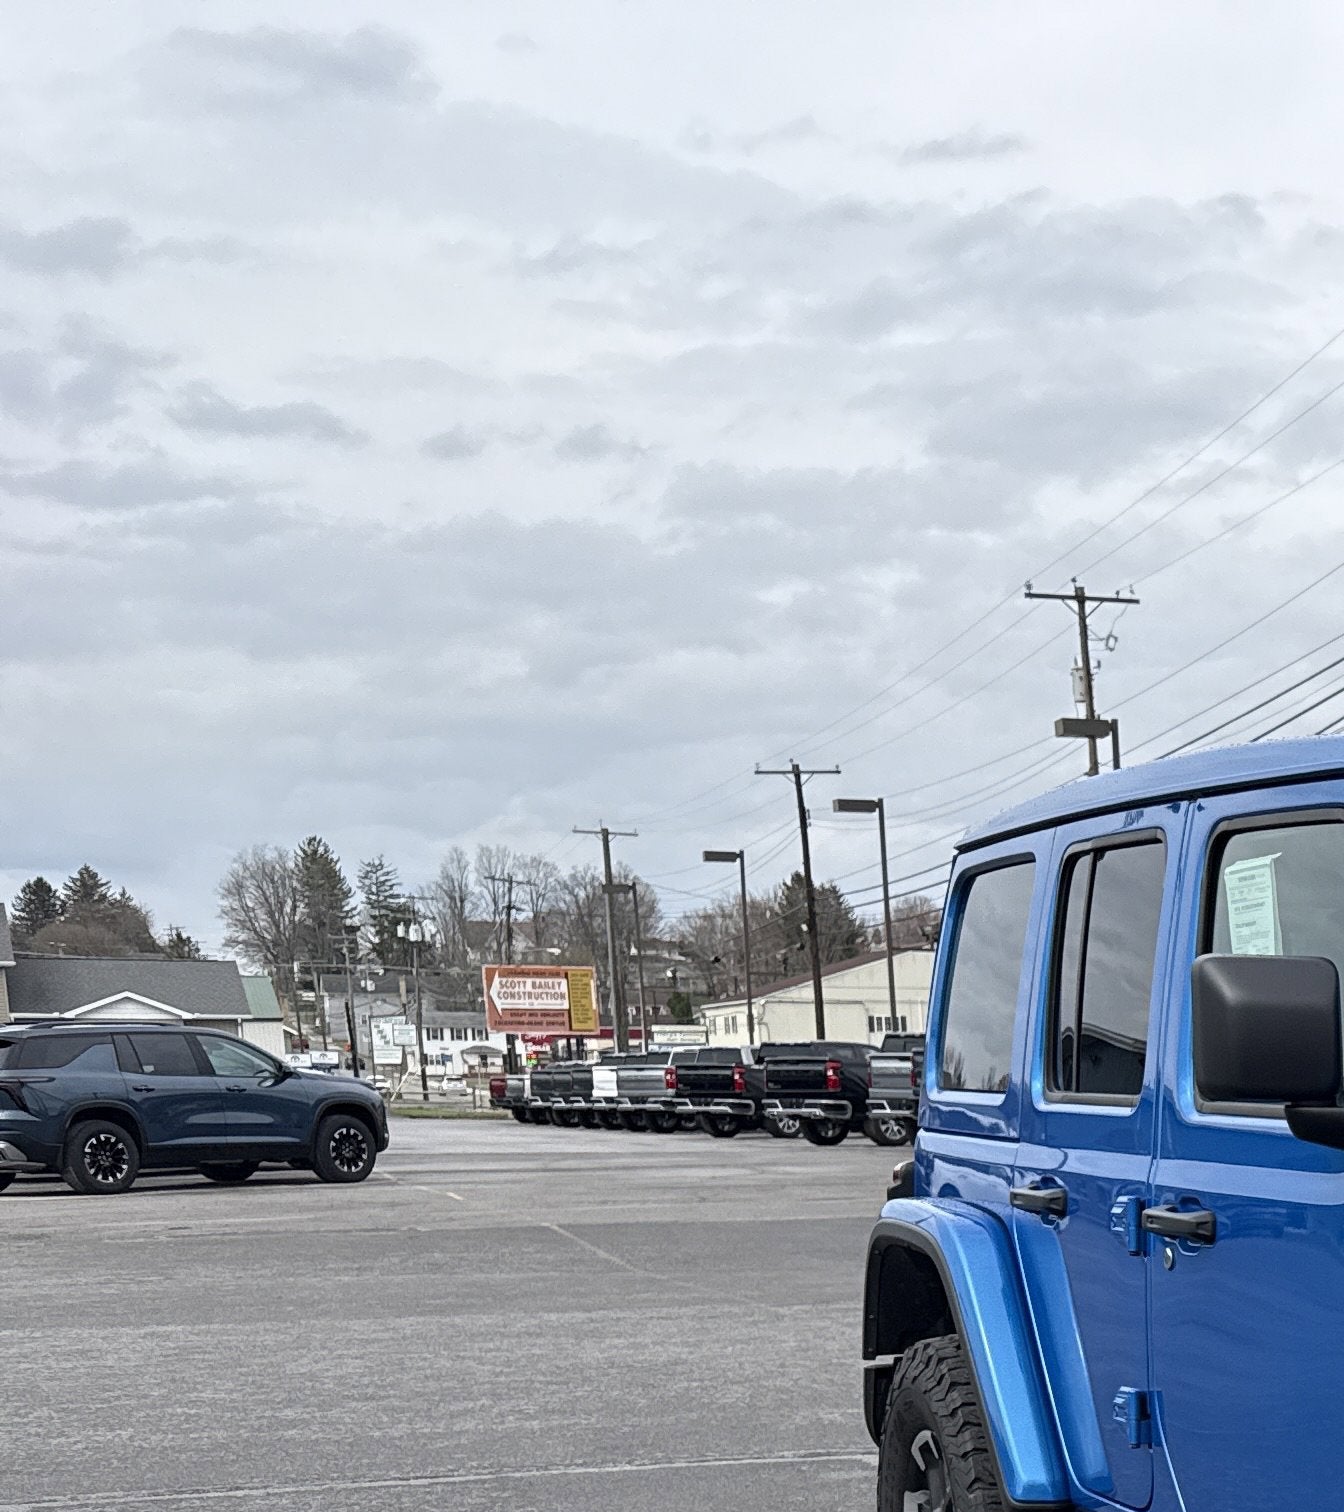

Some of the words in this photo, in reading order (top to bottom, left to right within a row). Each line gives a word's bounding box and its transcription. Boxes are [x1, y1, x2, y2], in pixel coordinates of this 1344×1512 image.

[499, 980, 527, 990] SCOTT
[531, 980, 563, 990] BAILEY
[497, 990, 566, 1001] CONSTRUCTION
